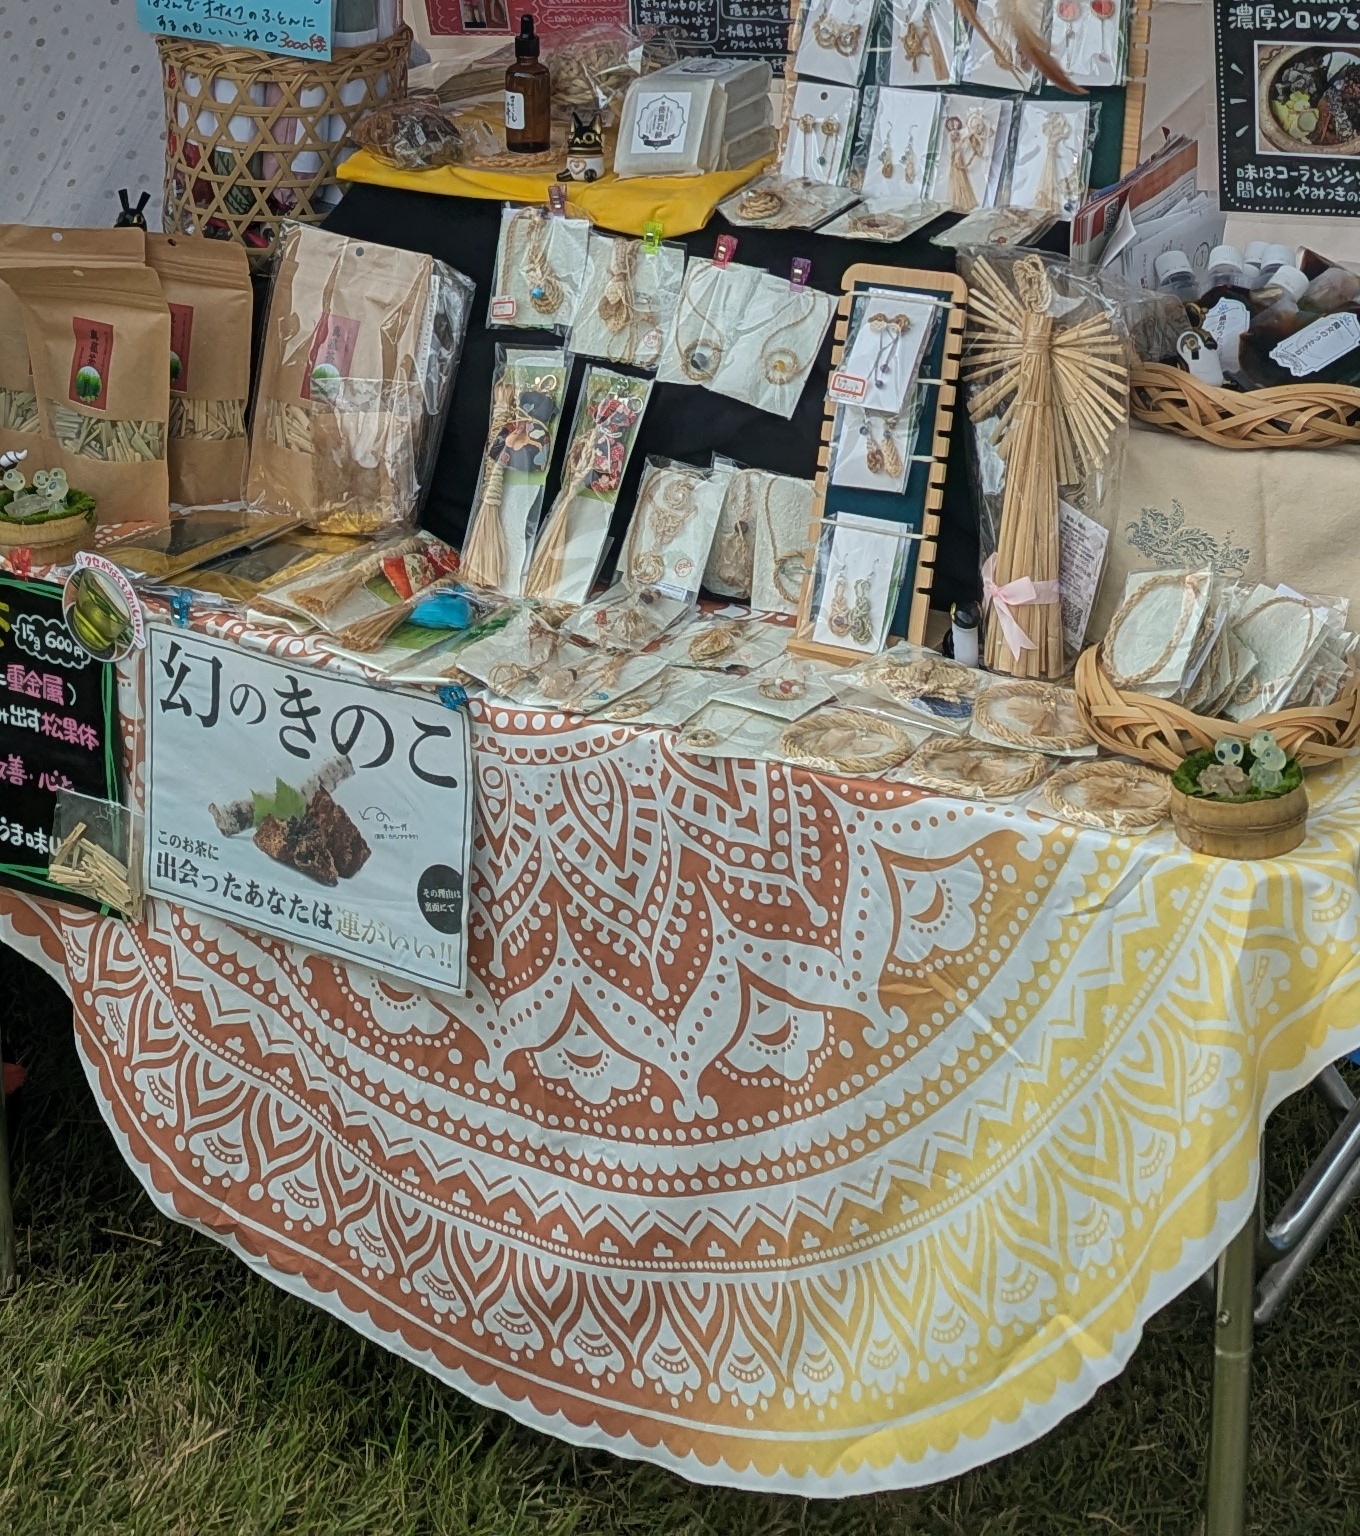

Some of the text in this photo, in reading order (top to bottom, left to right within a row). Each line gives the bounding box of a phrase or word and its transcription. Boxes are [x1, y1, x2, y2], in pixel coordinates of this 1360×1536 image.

[159, 641, 458, 789] 幻のきのこ
[158, 829, 220, 861] このお茶に
